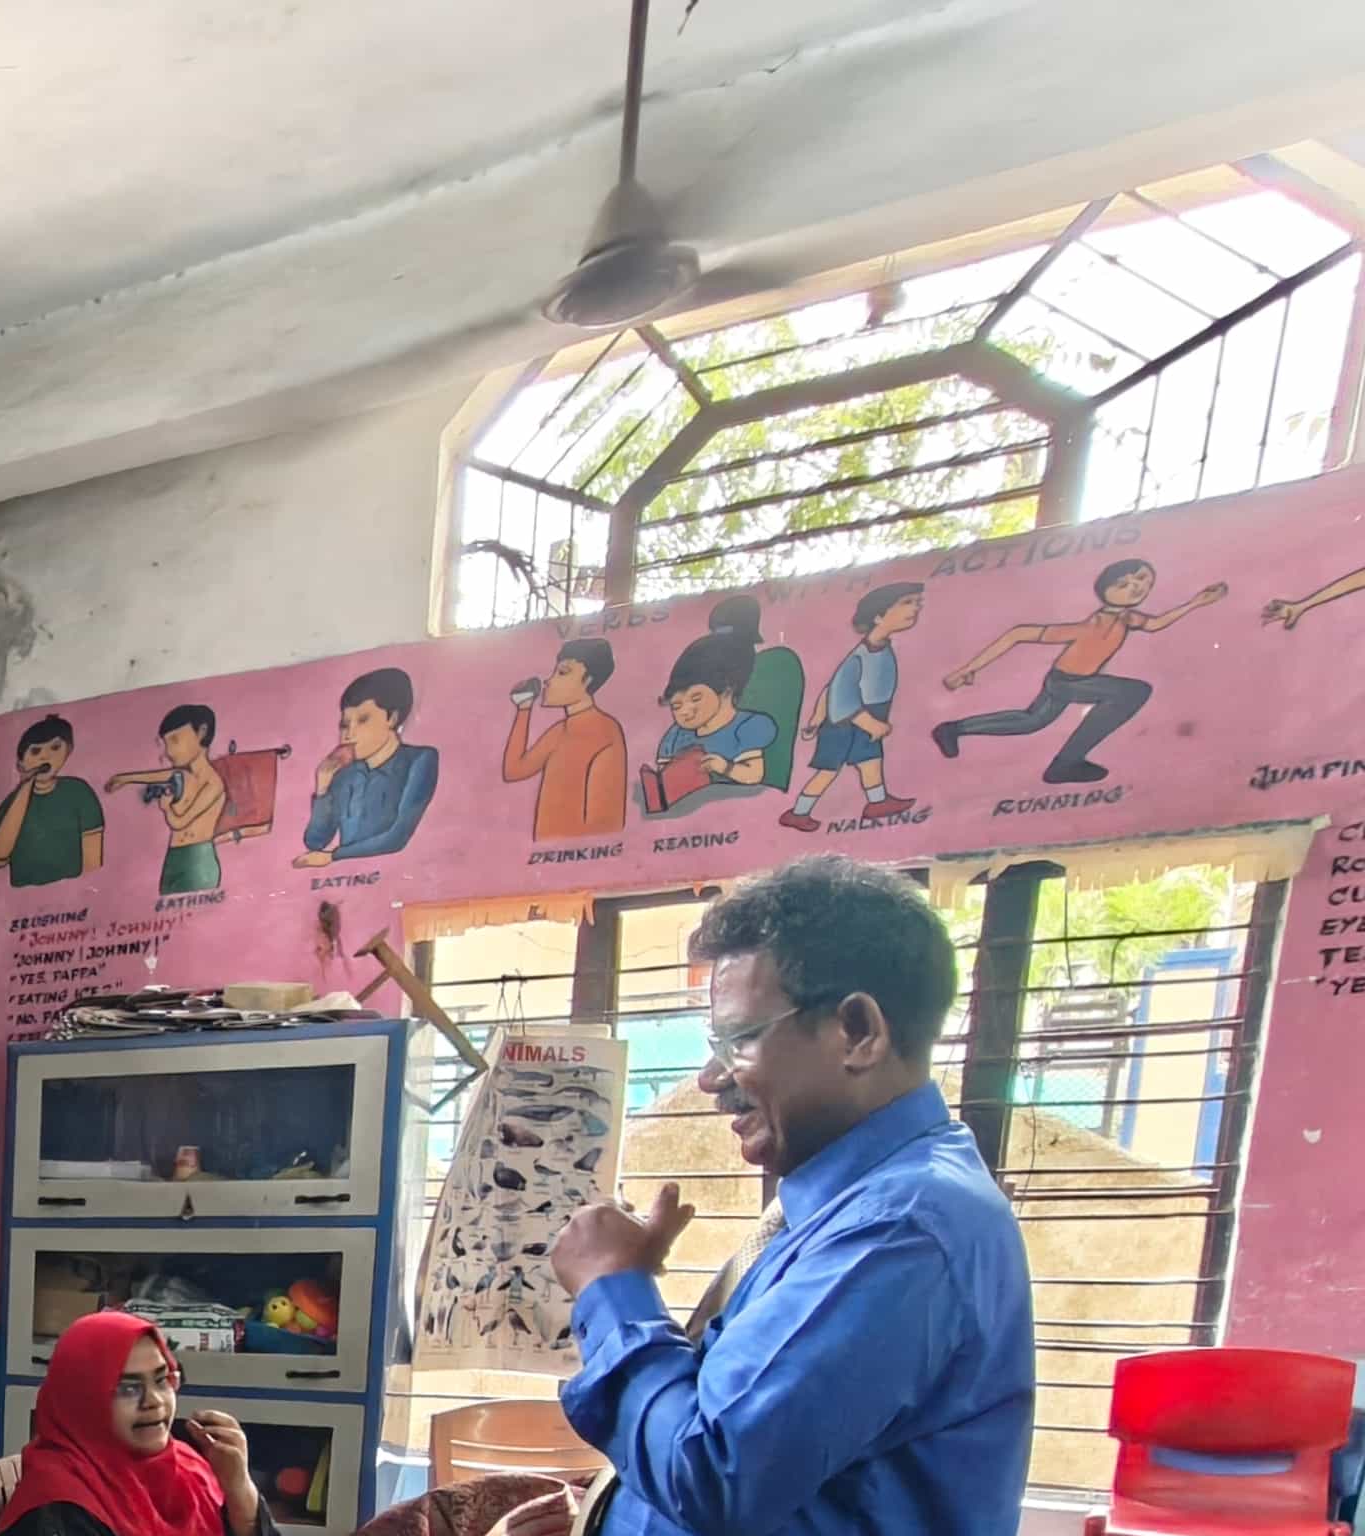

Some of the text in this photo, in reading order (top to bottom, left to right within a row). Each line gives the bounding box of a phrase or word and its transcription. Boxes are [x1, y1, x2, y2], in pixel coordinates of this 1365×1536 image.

[928, 525, 1142, 579] ACTIONS
[992, 785, 1125, 819] RUNNING
[826, 806, 933, 834] WALKING
[528, 841, 624, 867] DRINKING
[652, 830, 740, 854] READING
[310, 871, 381, 891] EATING
[501, 1043, 587, 1063] NIMALS
